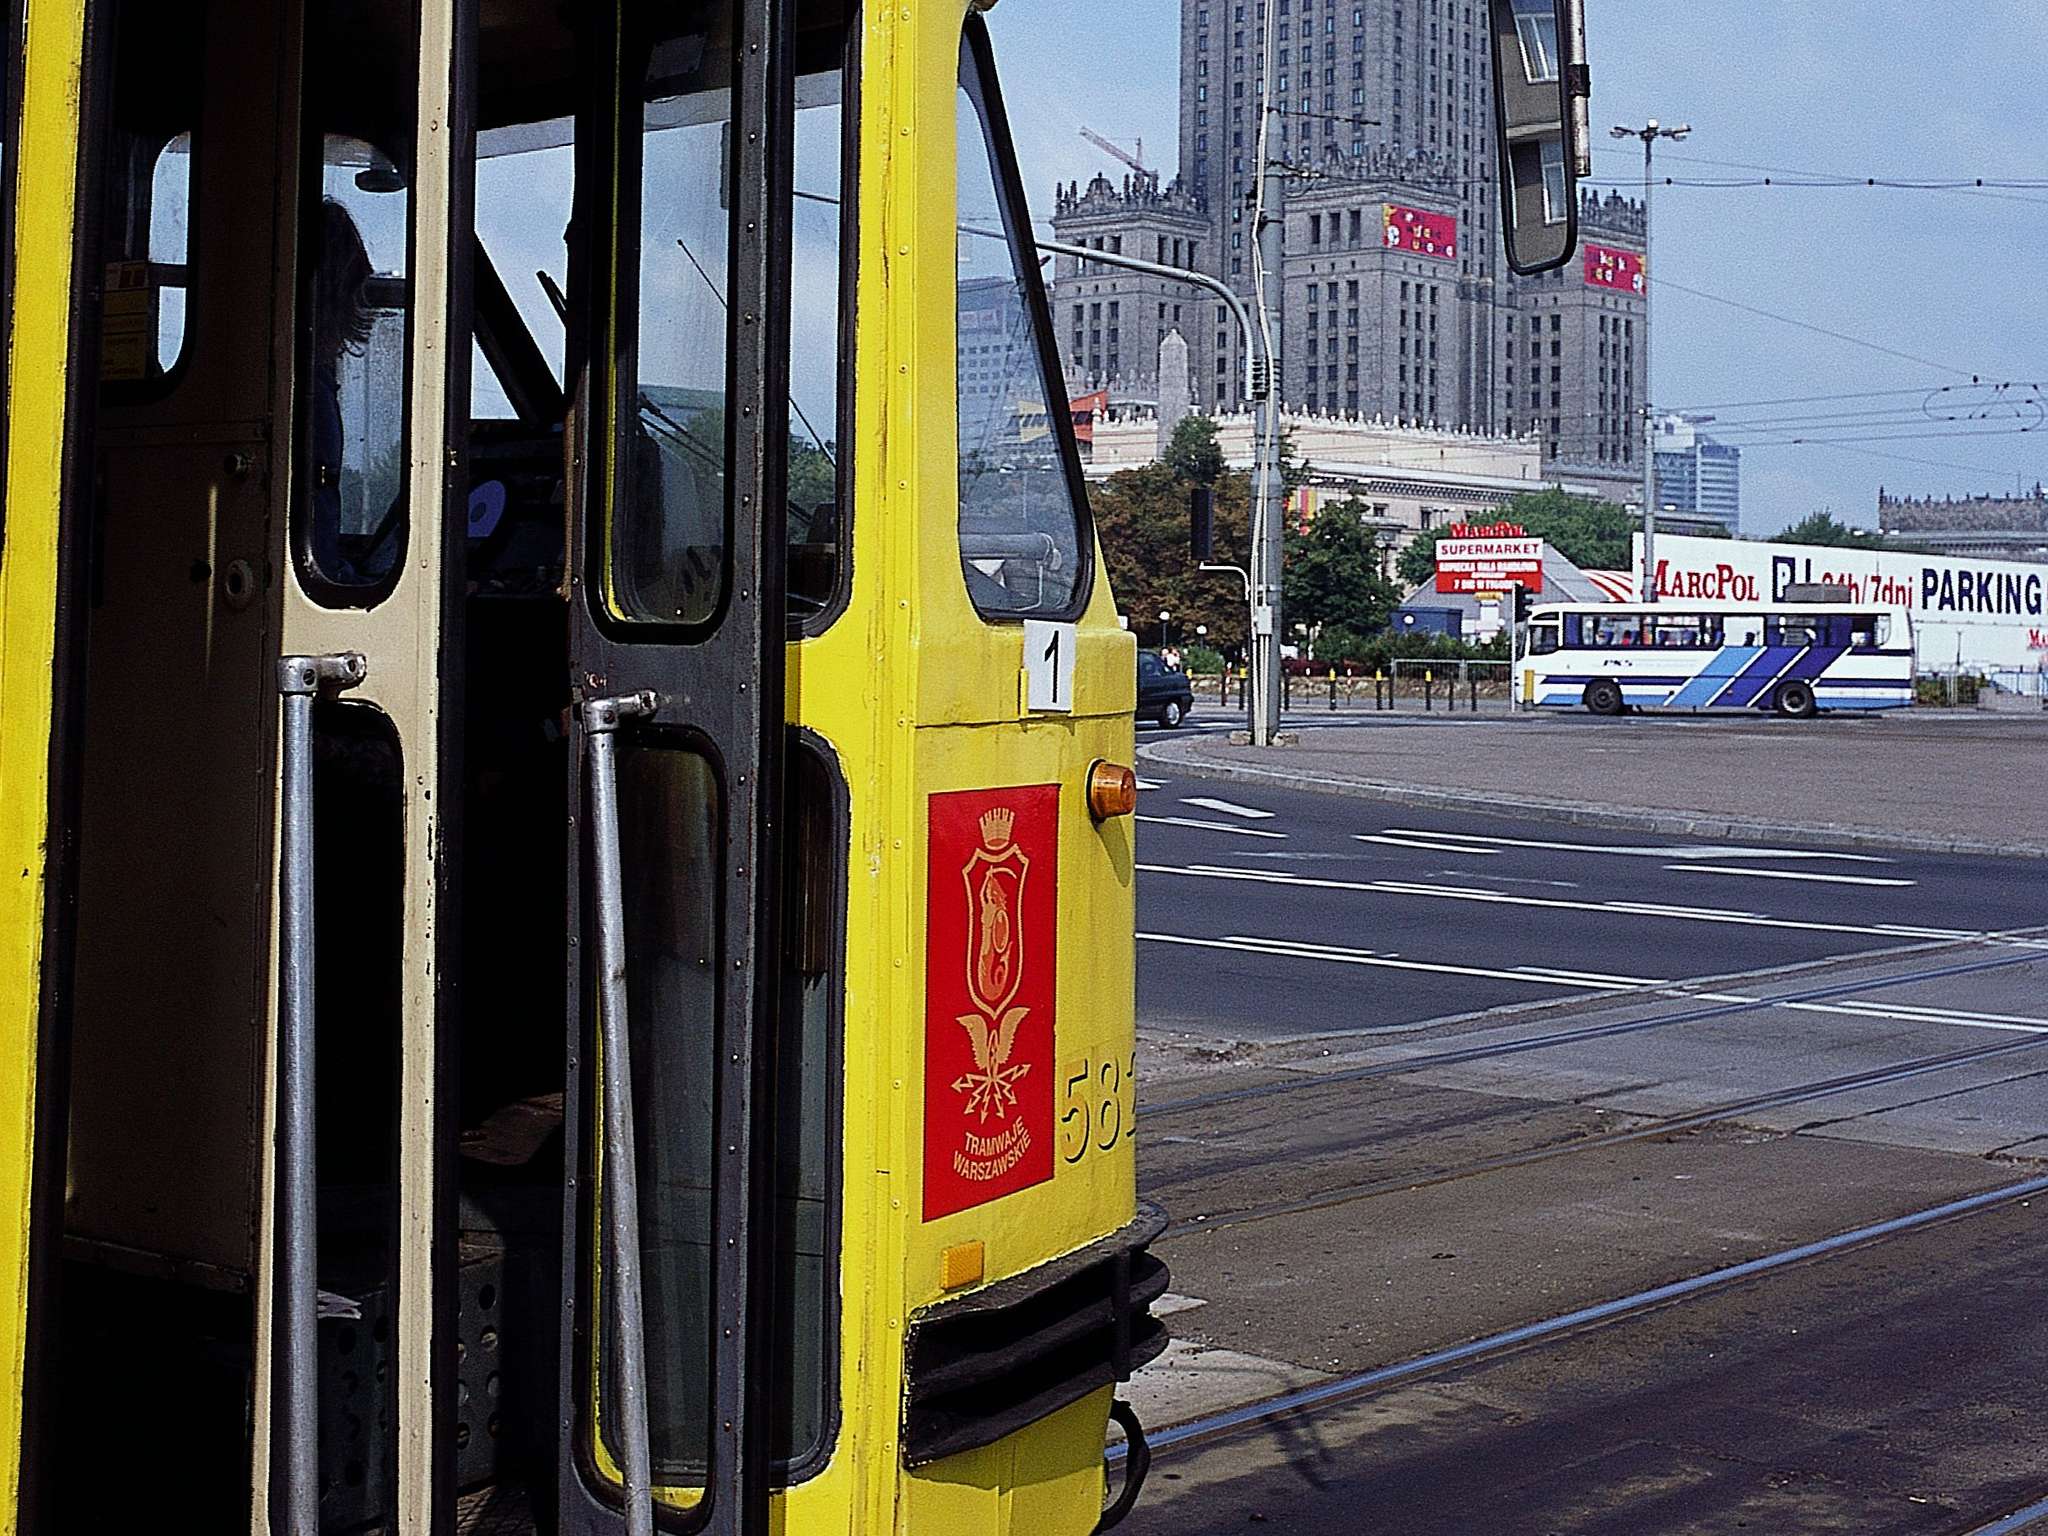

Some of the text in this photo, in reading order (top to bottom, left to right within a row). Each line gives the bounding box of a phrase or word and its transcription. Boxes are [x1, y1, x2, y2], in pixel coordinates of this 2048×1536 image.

[1441, 543, 1540, 555] SUPERMARKET
[1922, 567, 2042, 615] PARKING
[1044, 630, 1060, 704] 1
[953, 1128, 1032, 1182] WARSZAWSKIE
[965, 1115, 1024, 1157] TRAMWAJE
